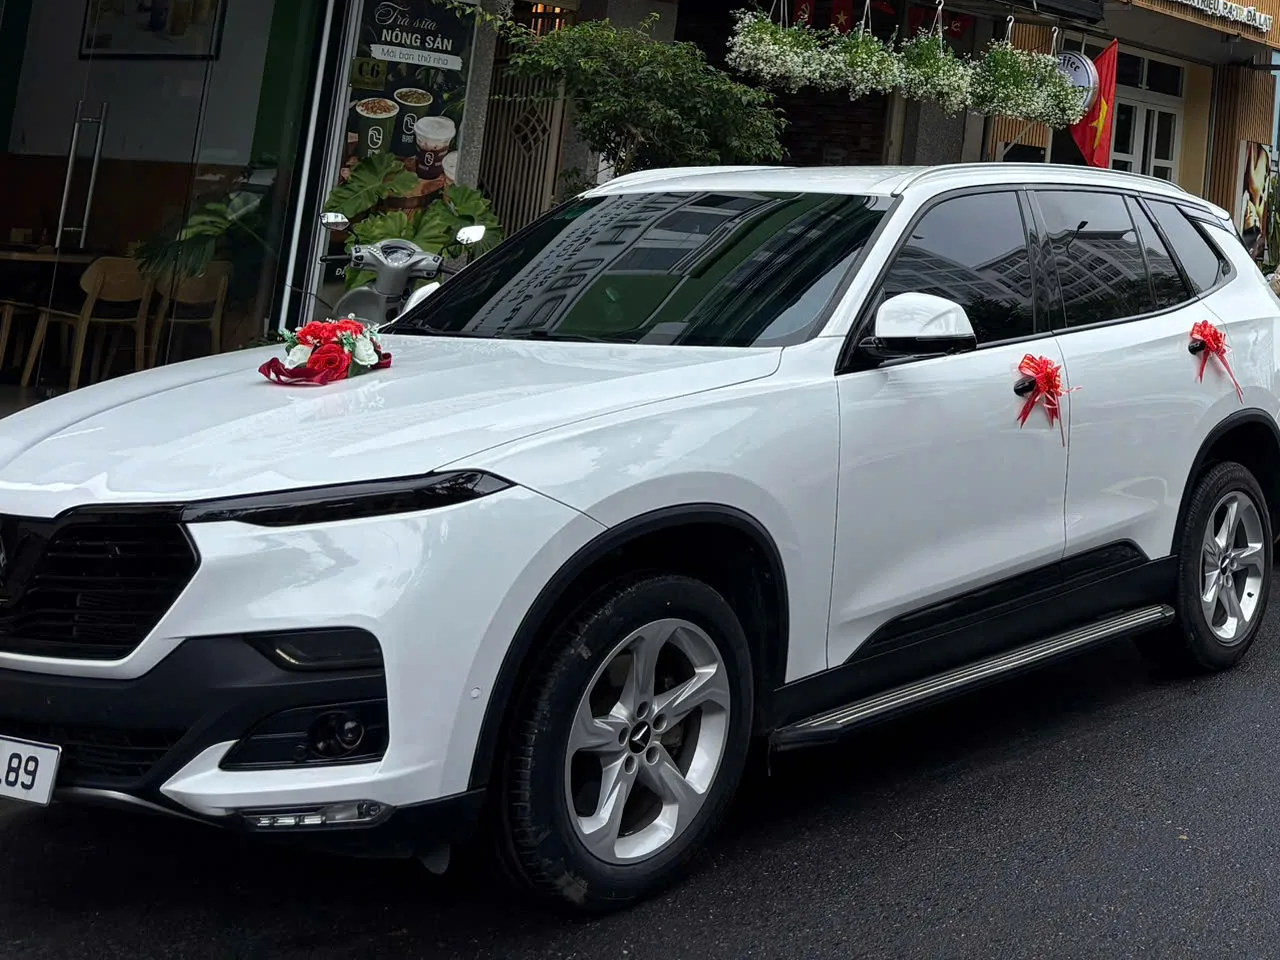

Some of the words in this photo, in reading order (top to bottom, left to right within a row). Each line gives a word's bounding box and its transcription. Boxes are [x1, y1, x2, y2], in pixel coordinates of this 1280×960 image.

[375, 1, 410, 27] Trà
[381, 28, 421, 47] NÔNG
[425, 33, 453, 51] SẢN
[358, 61, 380, 78] C6
